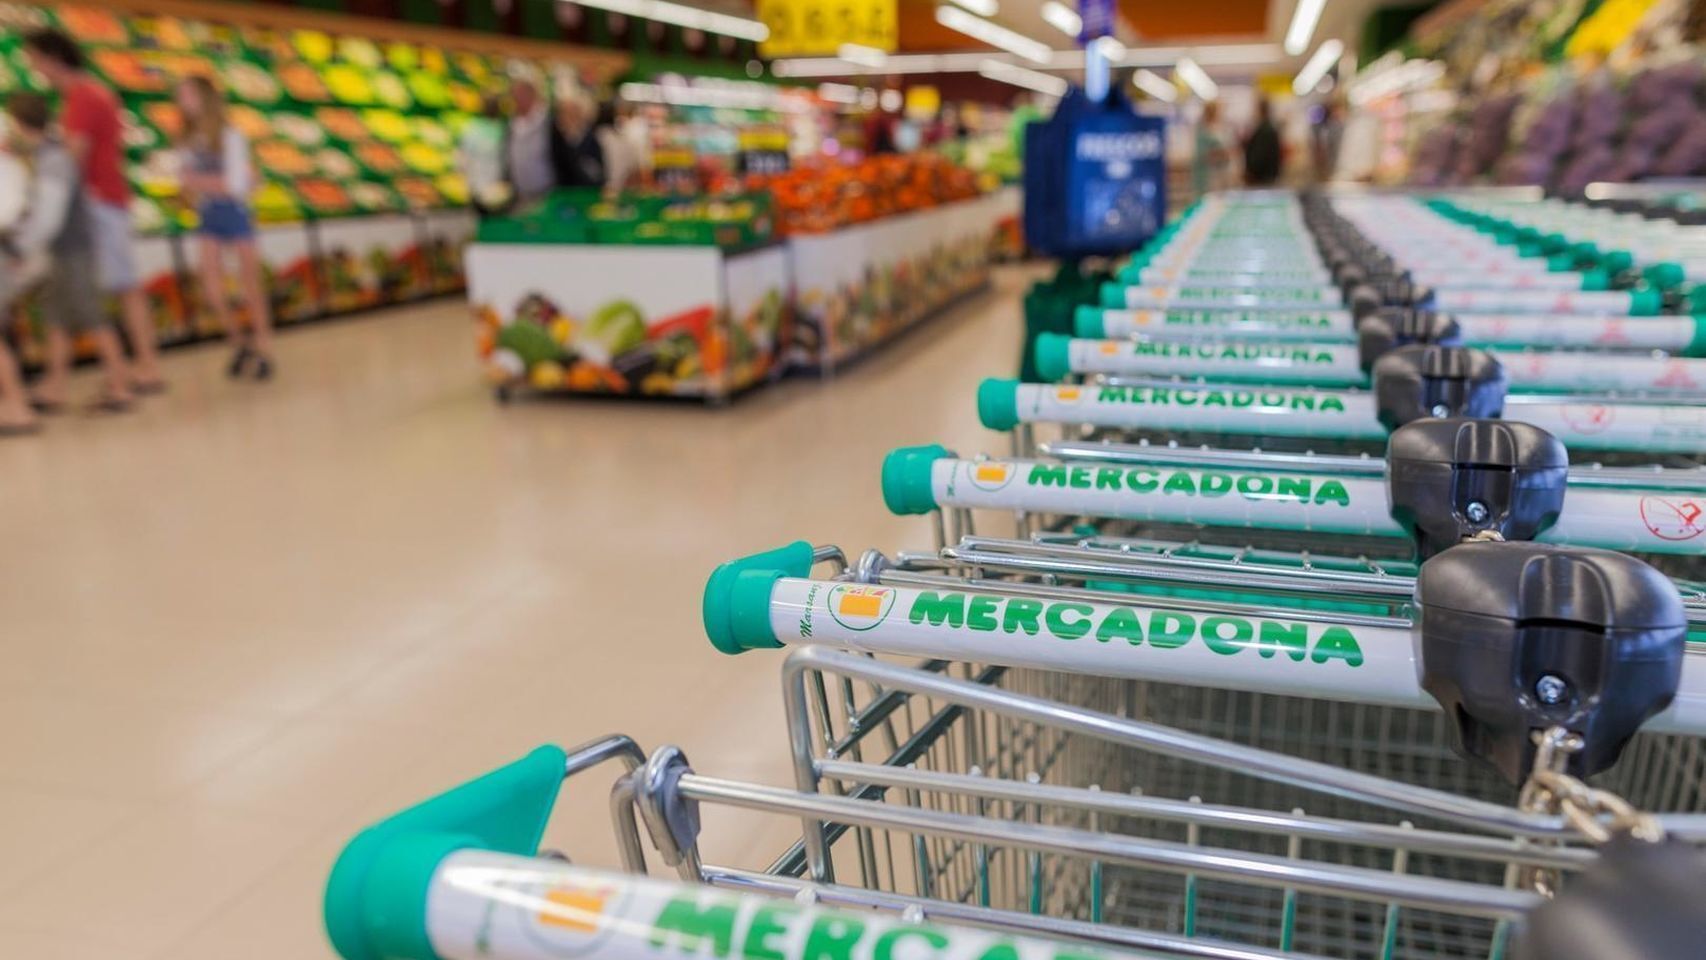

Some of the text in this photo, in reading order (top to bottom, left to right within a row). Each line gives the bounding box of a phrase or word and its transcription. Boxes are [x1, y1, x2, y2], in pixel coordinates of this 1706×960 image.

[1134, 341, 1333, 363] MERCADONA
[1099, 387, 1345, 412] MERCADONA
[1027, 463, 1351, 507] MERCADONA
[908, 591, 1364, 667] MERCADONA
